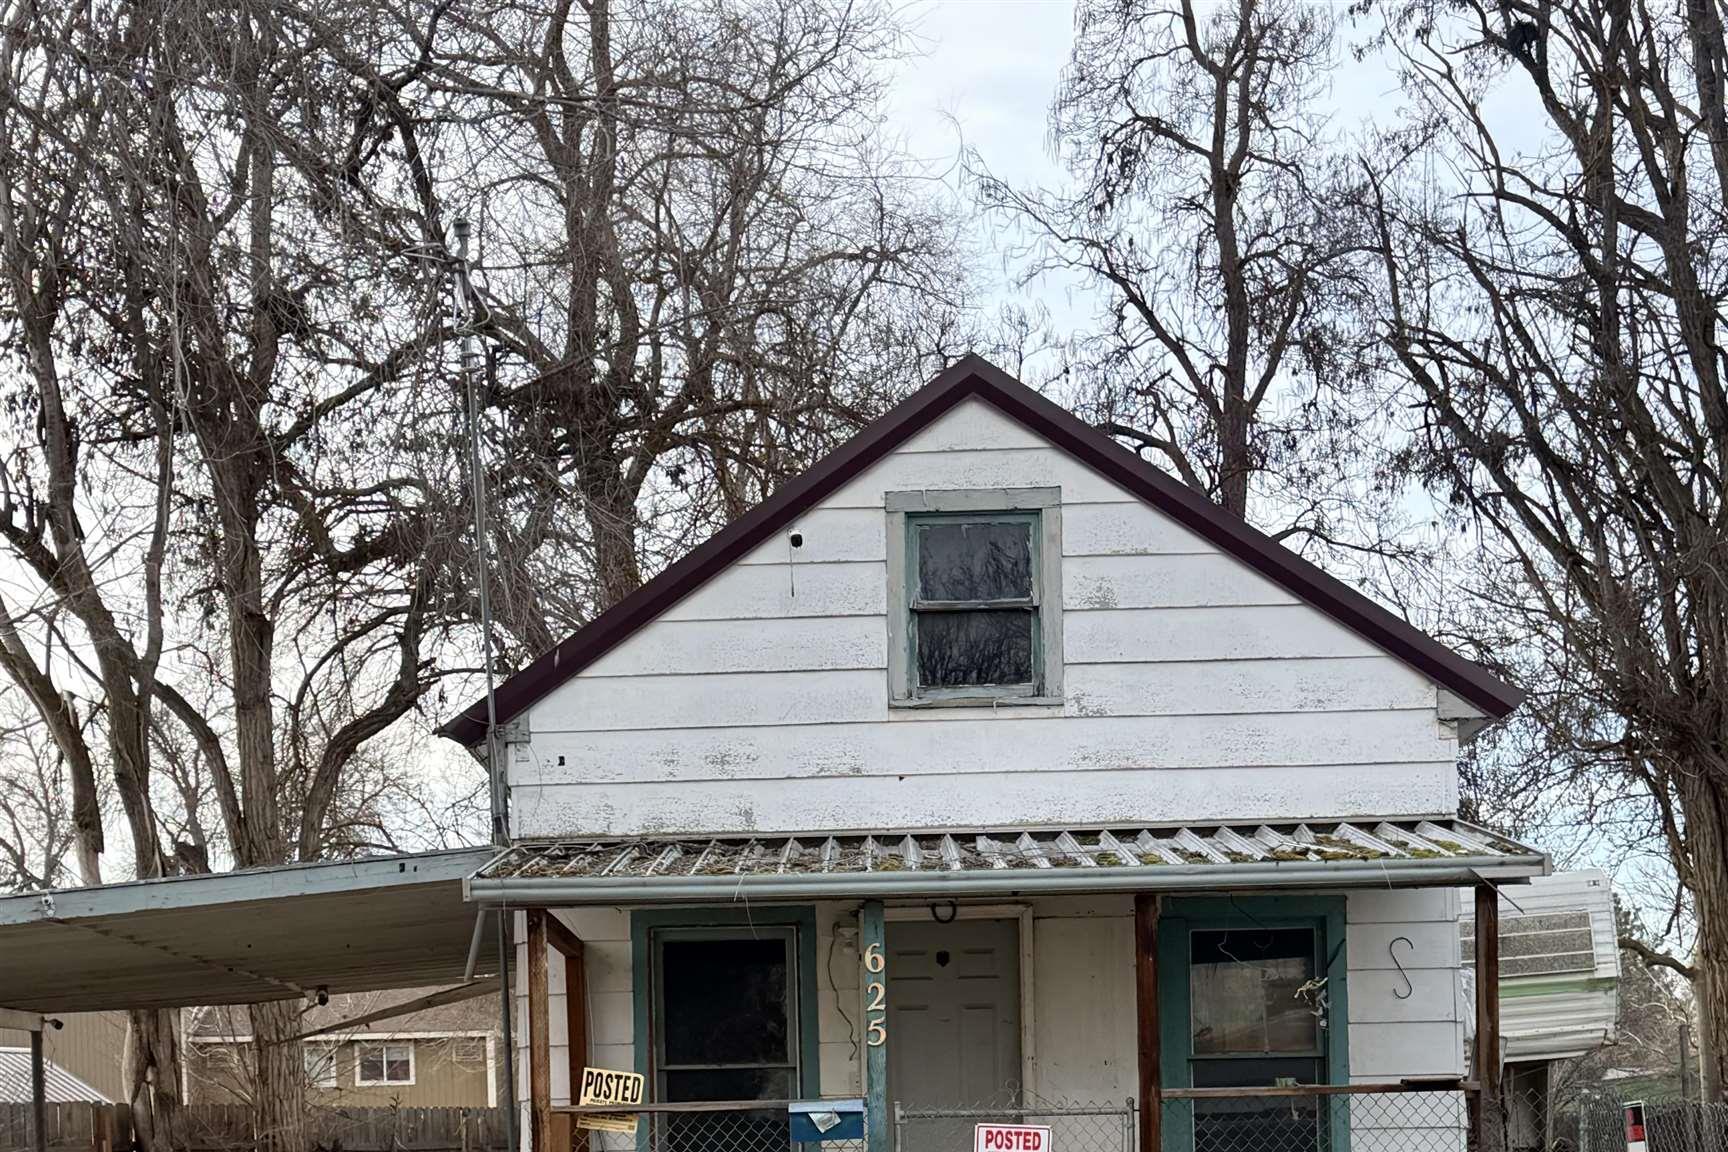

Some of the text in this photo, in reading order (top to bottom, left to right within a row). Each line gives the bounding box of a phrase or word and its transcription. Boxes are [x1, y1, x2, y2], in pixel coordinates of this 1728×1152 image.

[864, 942, 887, 1047] 625
[583, 1070, 641, 1103] POSTED
[985, 1129, 1042, 1151] POSTED
